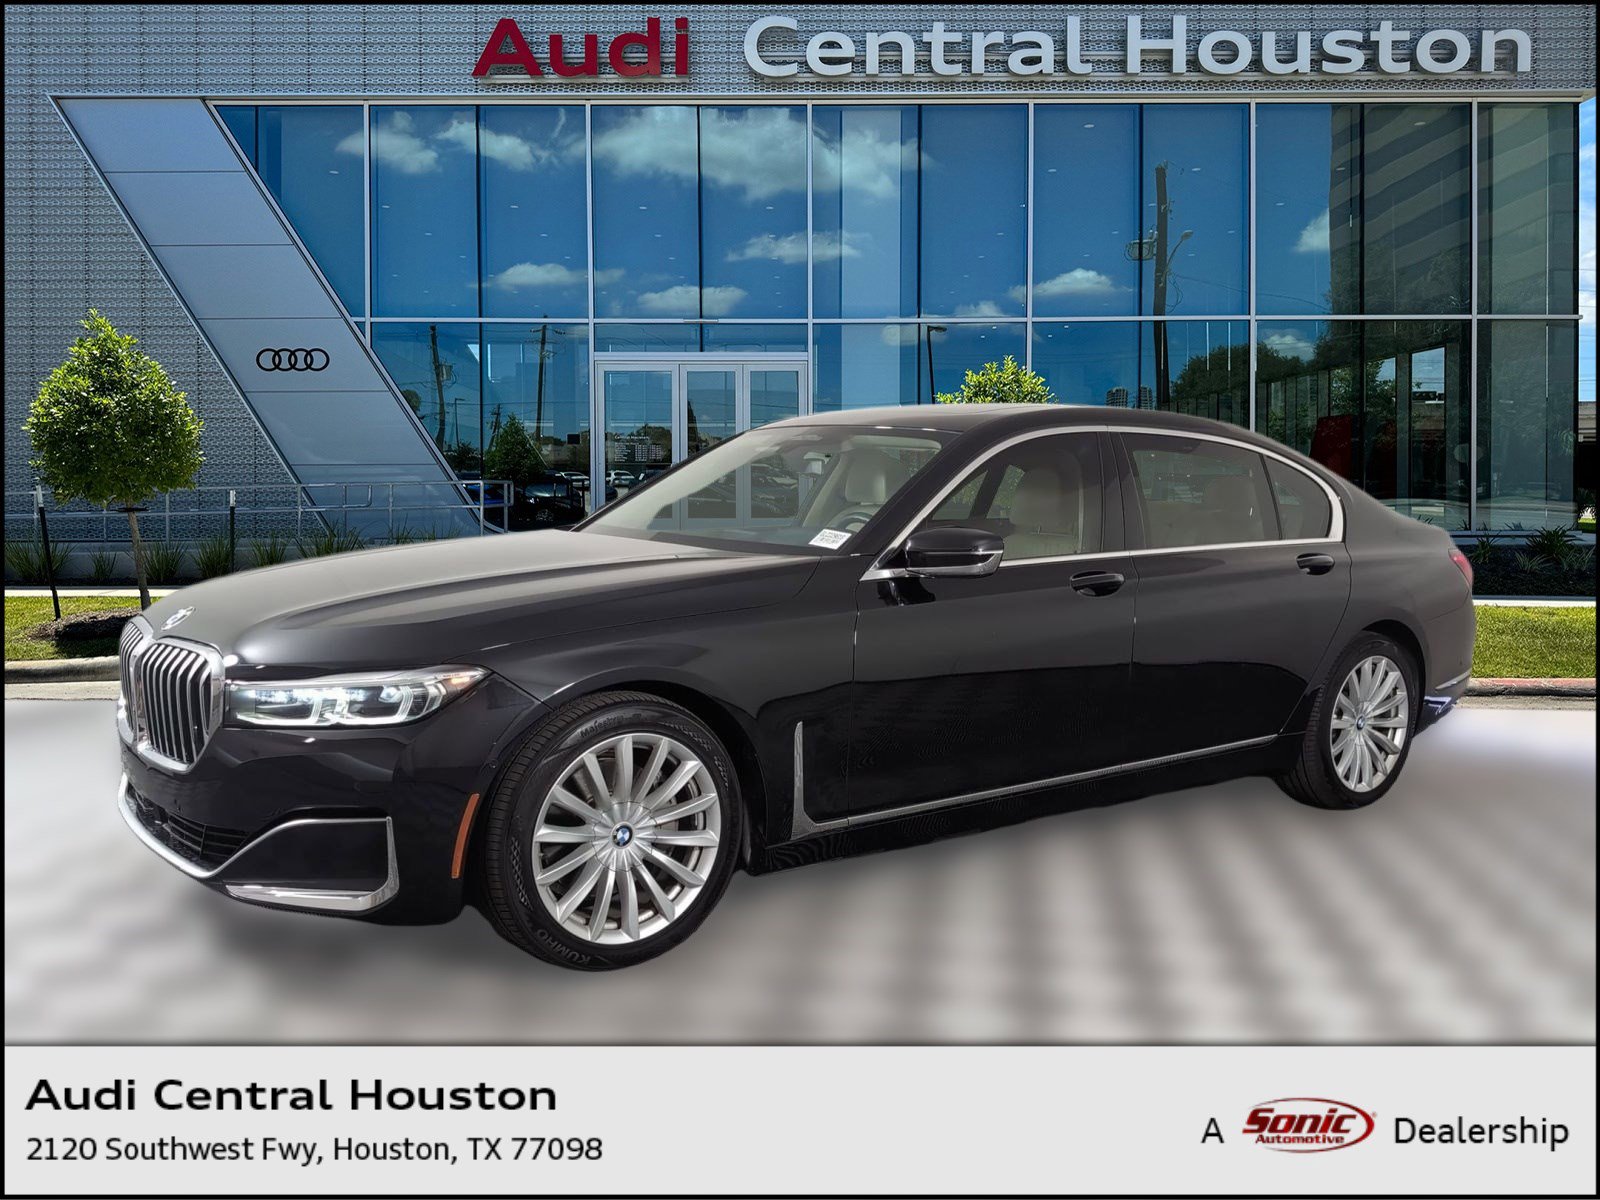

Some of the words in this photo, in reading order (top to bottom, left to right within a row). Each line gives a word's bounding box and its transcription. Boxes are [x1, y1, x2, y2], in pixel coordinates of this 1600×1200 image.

[472, 17, 690, 77] Audi
[743, 15, 1093, 77] Central
[1126, 15, 1533, 75] Houston
[536, 928, 591, 965] KUMHO
